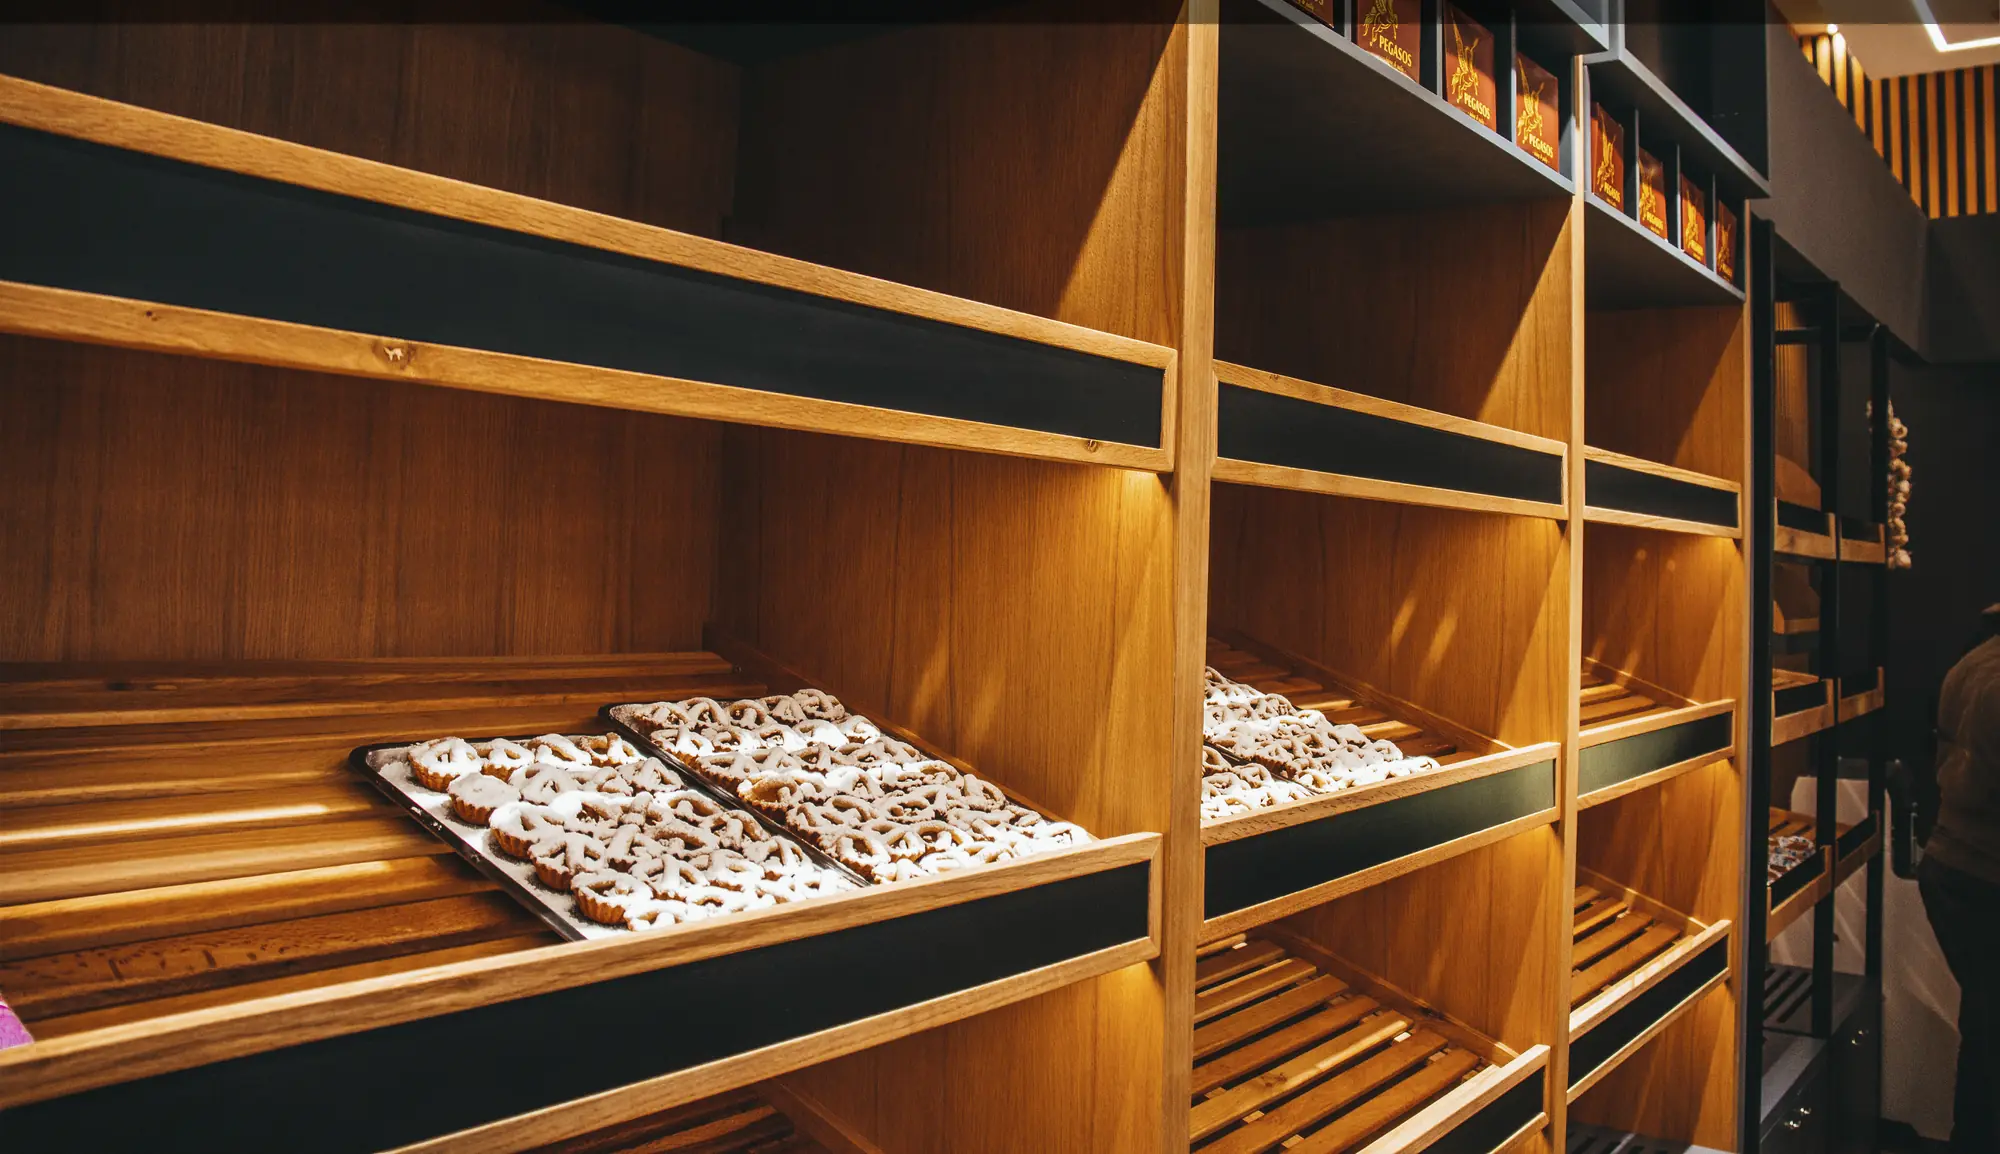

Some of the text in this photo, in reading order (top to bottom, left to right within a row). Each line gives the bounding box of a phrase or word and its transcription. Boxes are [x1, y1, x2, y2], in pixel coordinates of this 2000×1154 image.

[1379, 34, 1412, 67] PEGASOS
[1464, 92, 1491, 120] PEGASOS
[1529, 133, 1554, 158] PEGASOS
